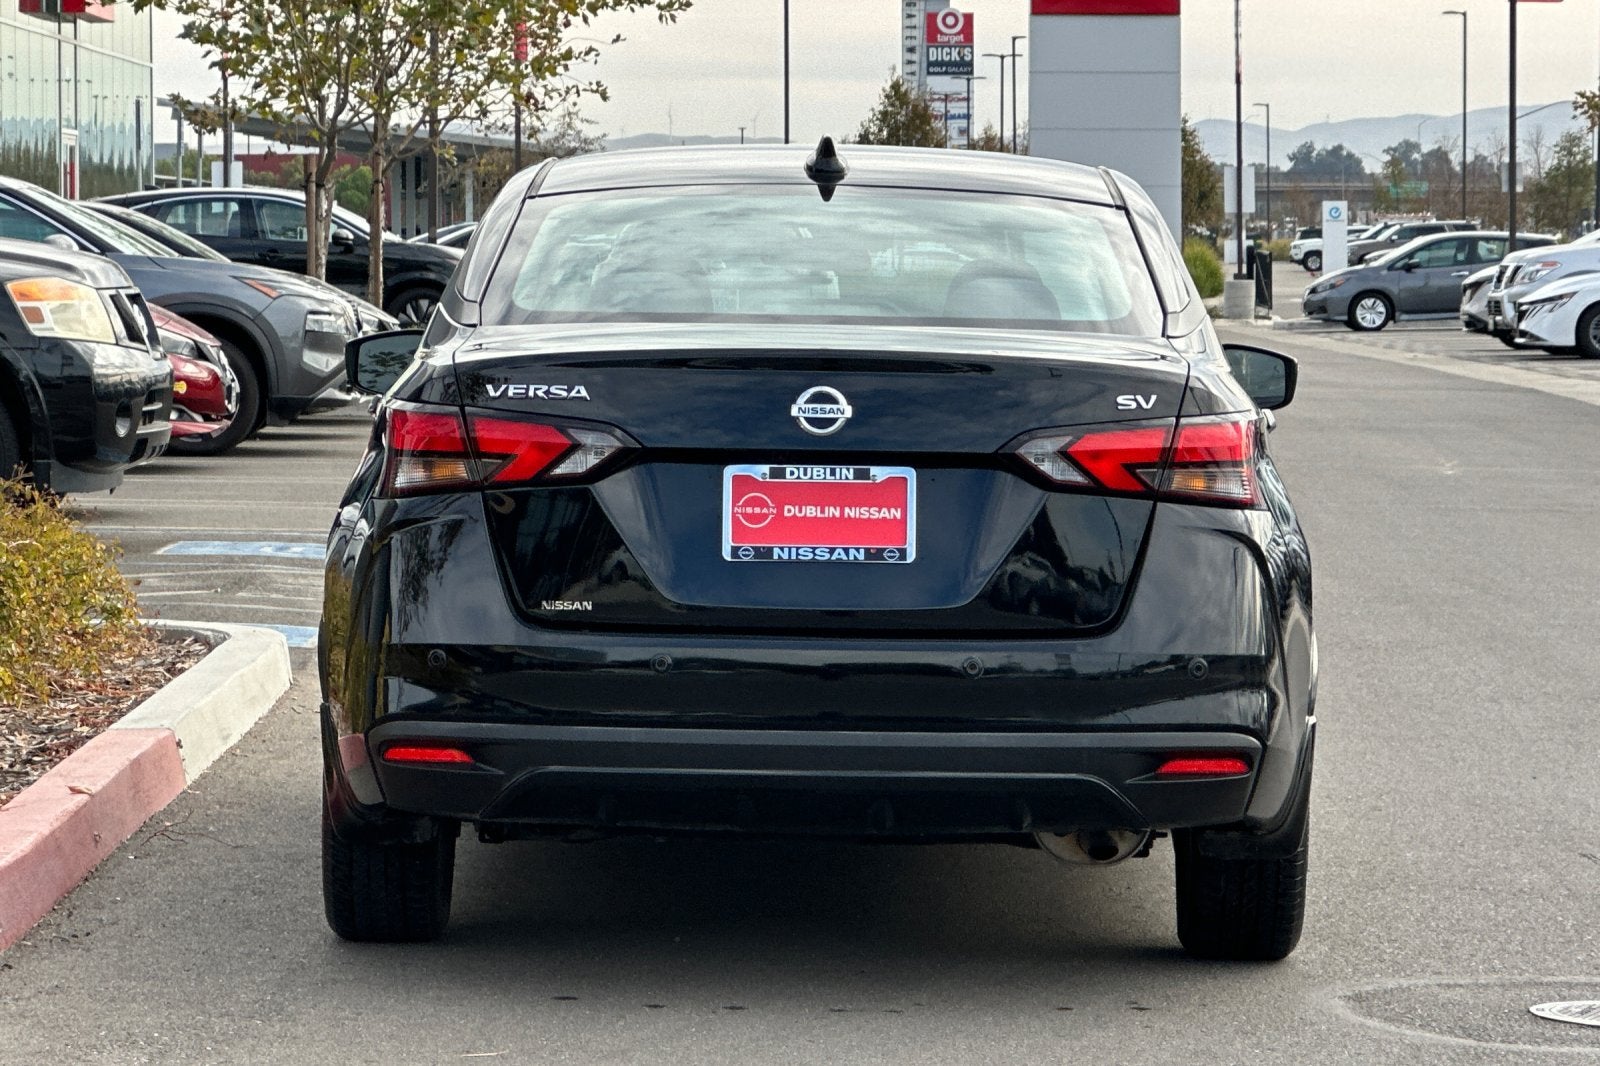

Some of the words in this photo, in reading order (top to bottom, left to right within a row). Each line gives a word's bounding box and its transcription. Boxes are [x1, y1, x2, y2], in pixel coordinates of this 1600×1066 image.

[905, 1, 917, 77] GATEWAY
[937, 33, 964, 44] target
[928, 46, 972, 62] DICK'S
[485, 384, 591, 400] VERSA
[1116, 394, 1157, 410] SV
[797, 406, 845, 415] NISSAN
[785, 467, 854, 480] DUBLIN
[734, 506, 777, 514] NISSAN
[783, 504, 840, 518] DUBLIN
[844, 506, 901, 520] NISSAN
[773, 547, 865, 561] NISSAN
[541, 600, 593, 611] NISSAN
